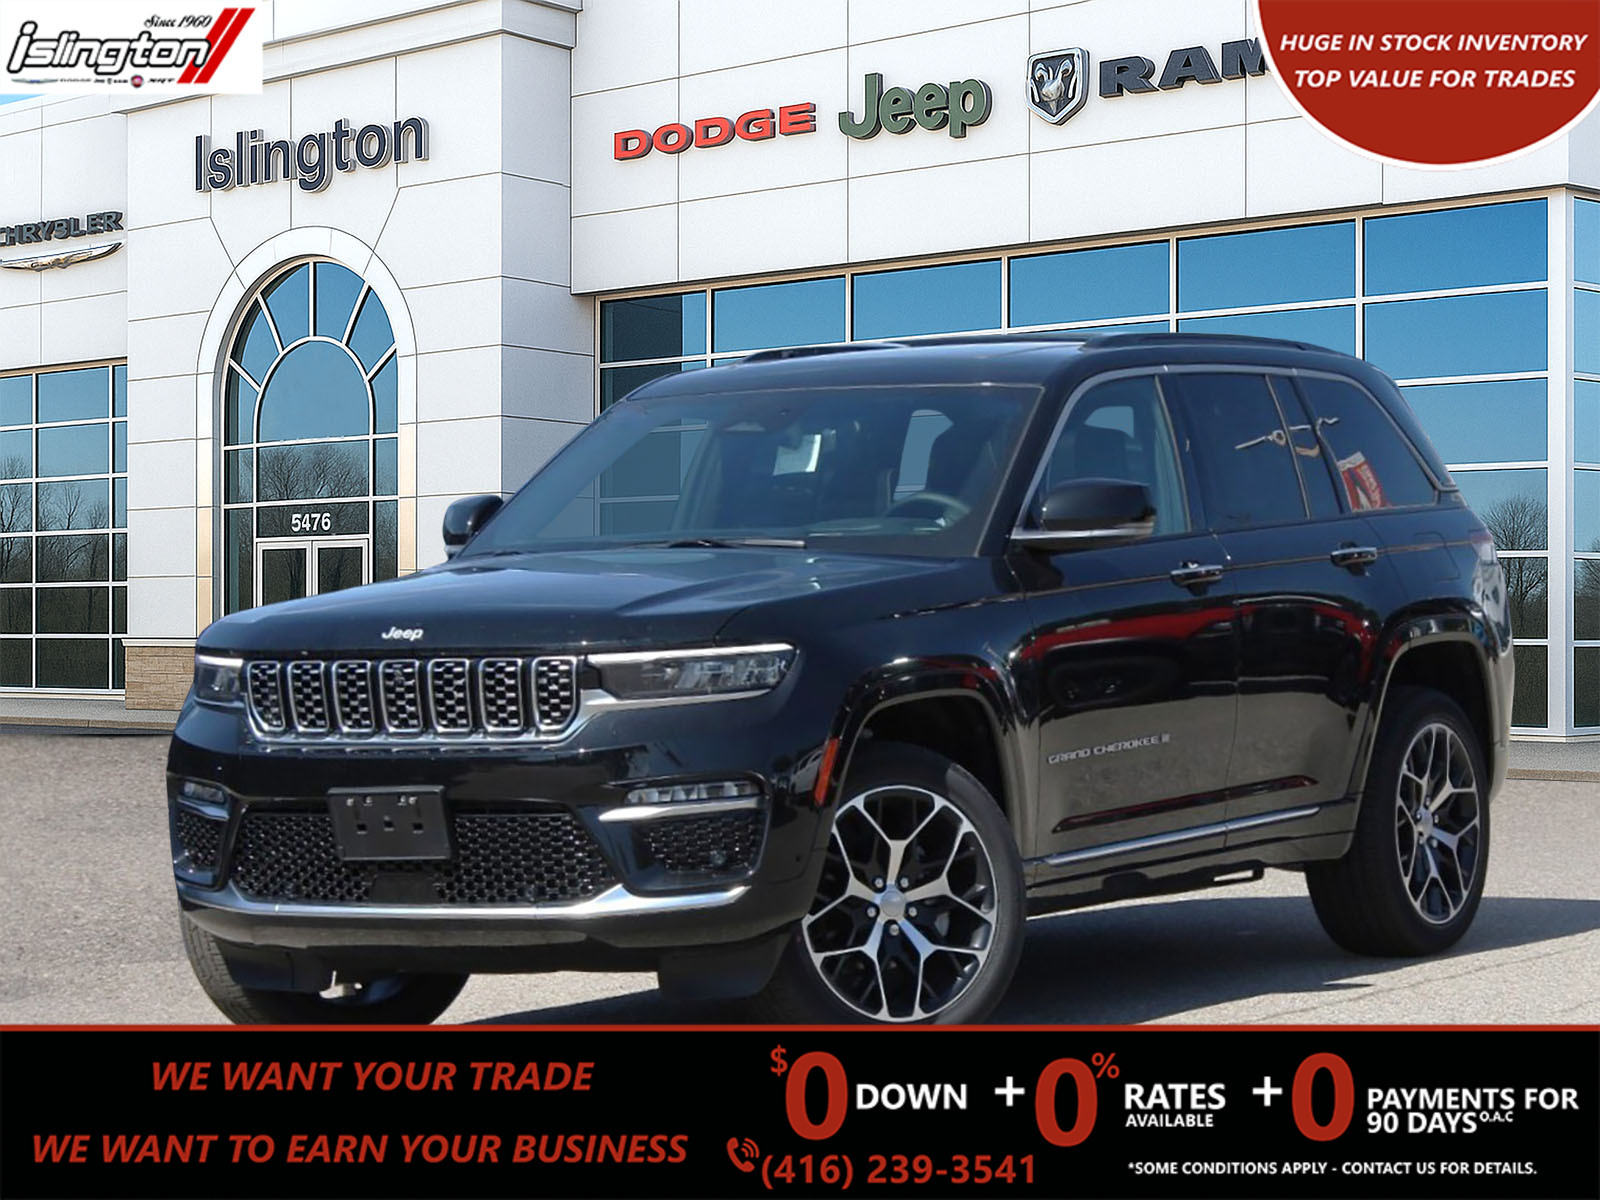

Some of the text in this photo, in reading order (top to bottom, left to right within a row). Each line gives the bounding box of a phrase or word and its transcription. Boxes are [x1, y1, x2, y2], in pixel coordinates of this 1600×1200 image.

[1098, 37, 1271, 99] RAM
[613, 101, 818, 161] DODGE
[838, 72, 992, 141] Jeep
[194, 115, 430, 193] Islington
[291, 512, 331, 532] 5476
[381, 626, 424, 642] Jeep
[1048, 735, 1159, 764] GRAND CHEROKEE
